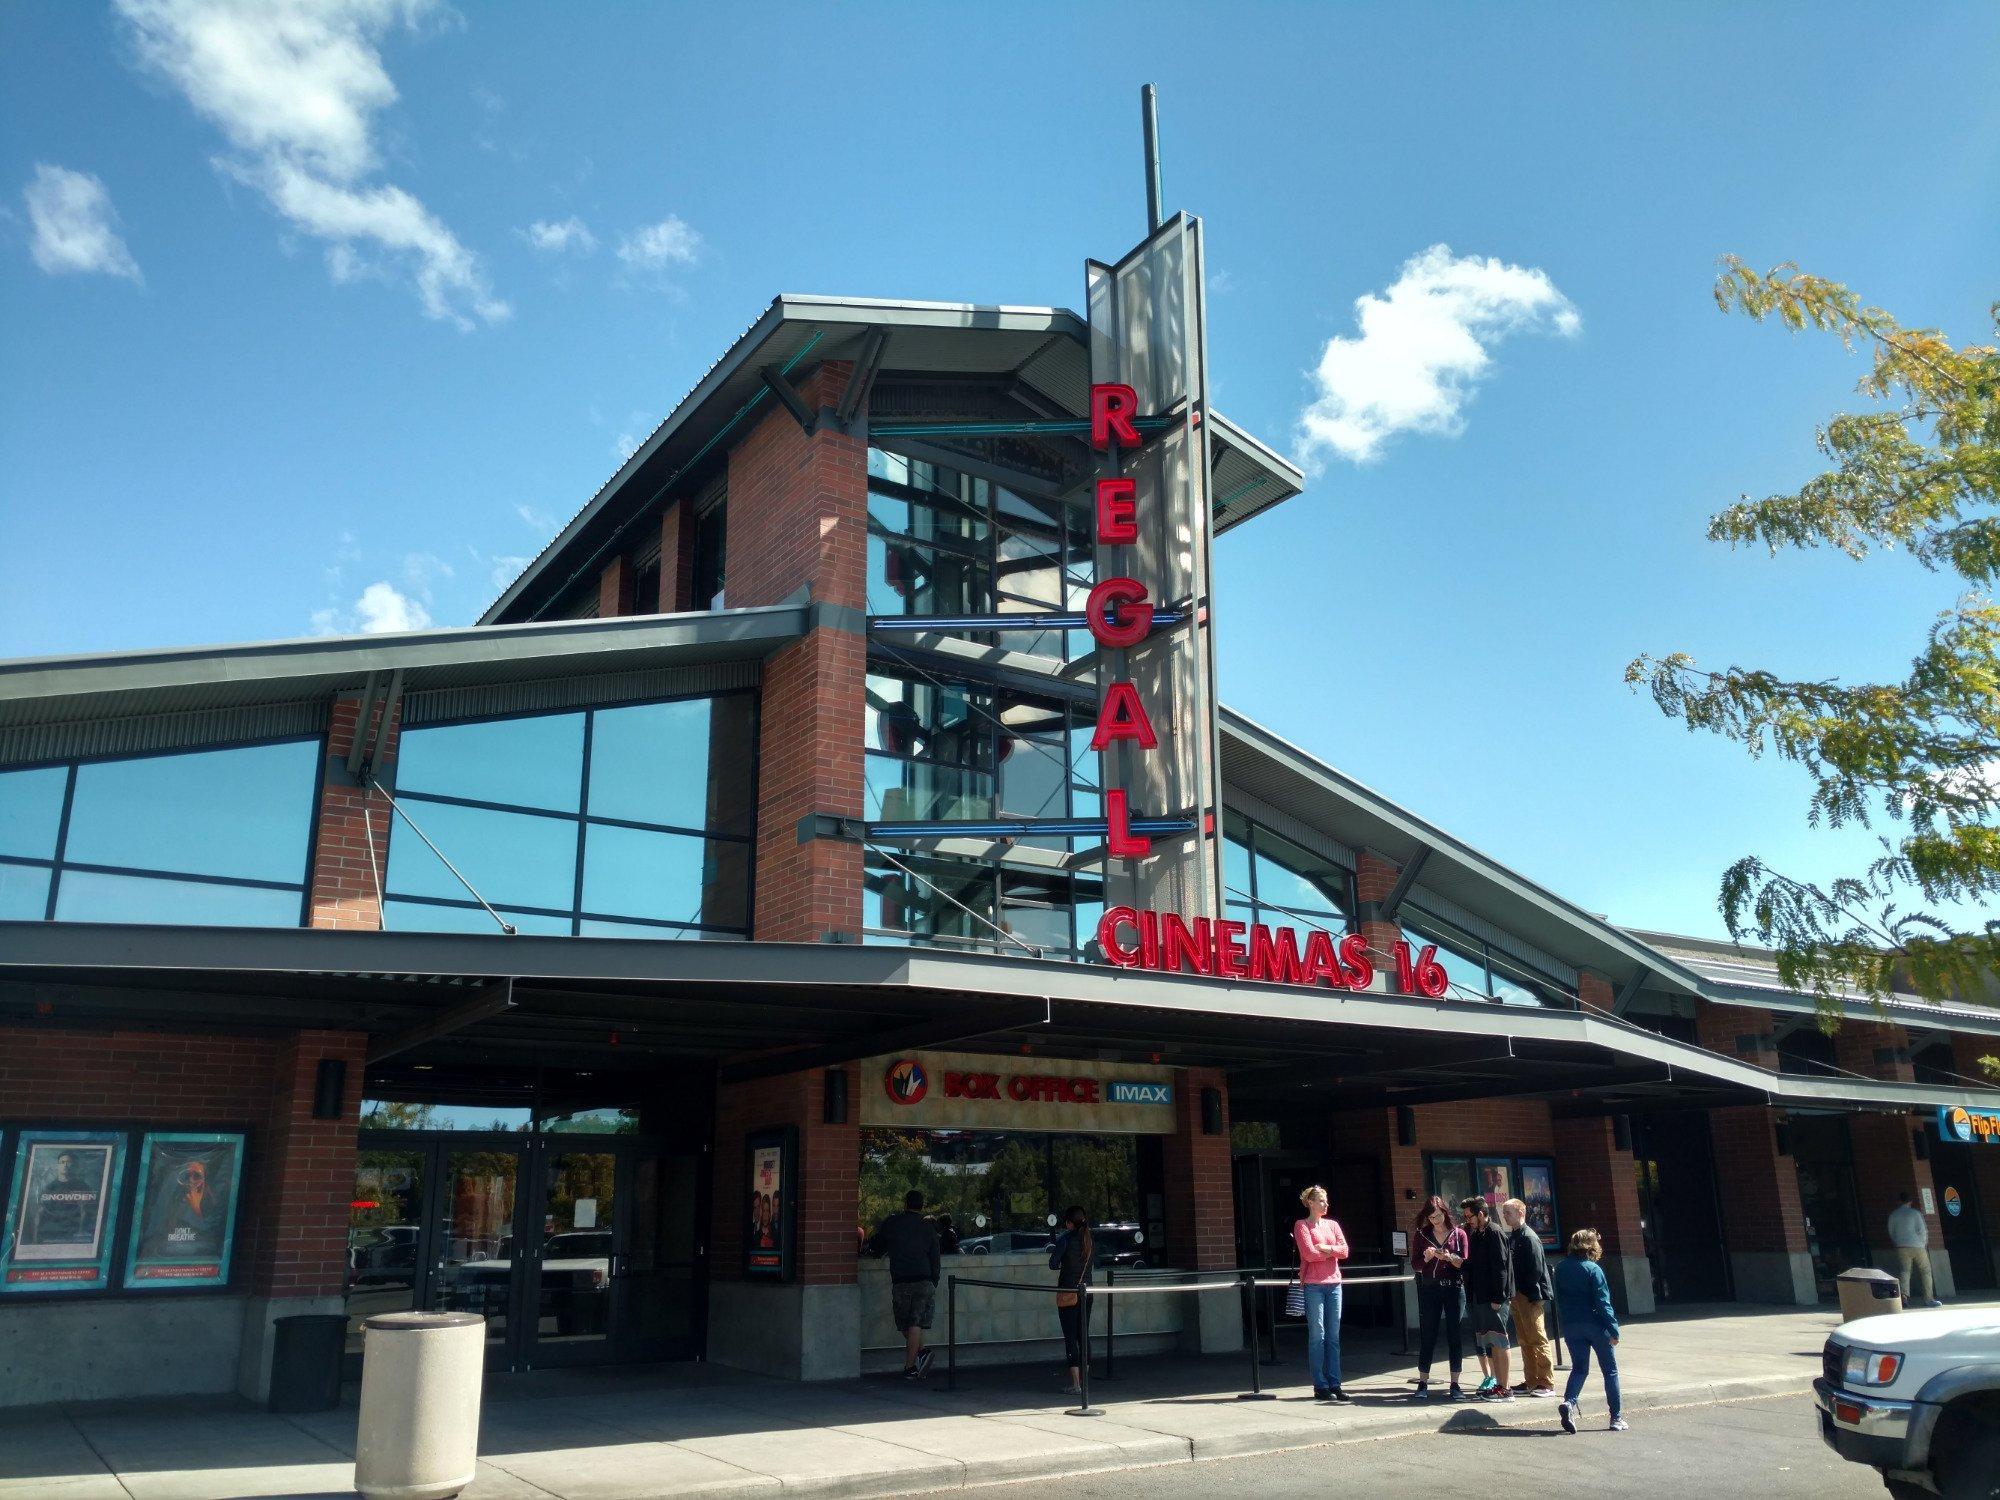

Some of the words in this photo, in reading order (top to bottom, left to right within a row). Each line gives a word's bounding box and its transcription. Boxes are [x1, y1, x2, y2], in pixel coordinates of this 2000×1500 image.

[1085, 383, 1158, 858] REGAL
[1097, 906, 1374, 991] CINEMAS
[1394, 940, 1449, 998] 16
[944, 1072, 1001, 1100] BOX
[1007, 1076, 1100, 1103] OFFICE
[1115, 1085, 1168, 1102] IMAX
[1970, 1114, 1991, 1143] Flip
[41, 1193, 97, 1201] SNOWDEN
